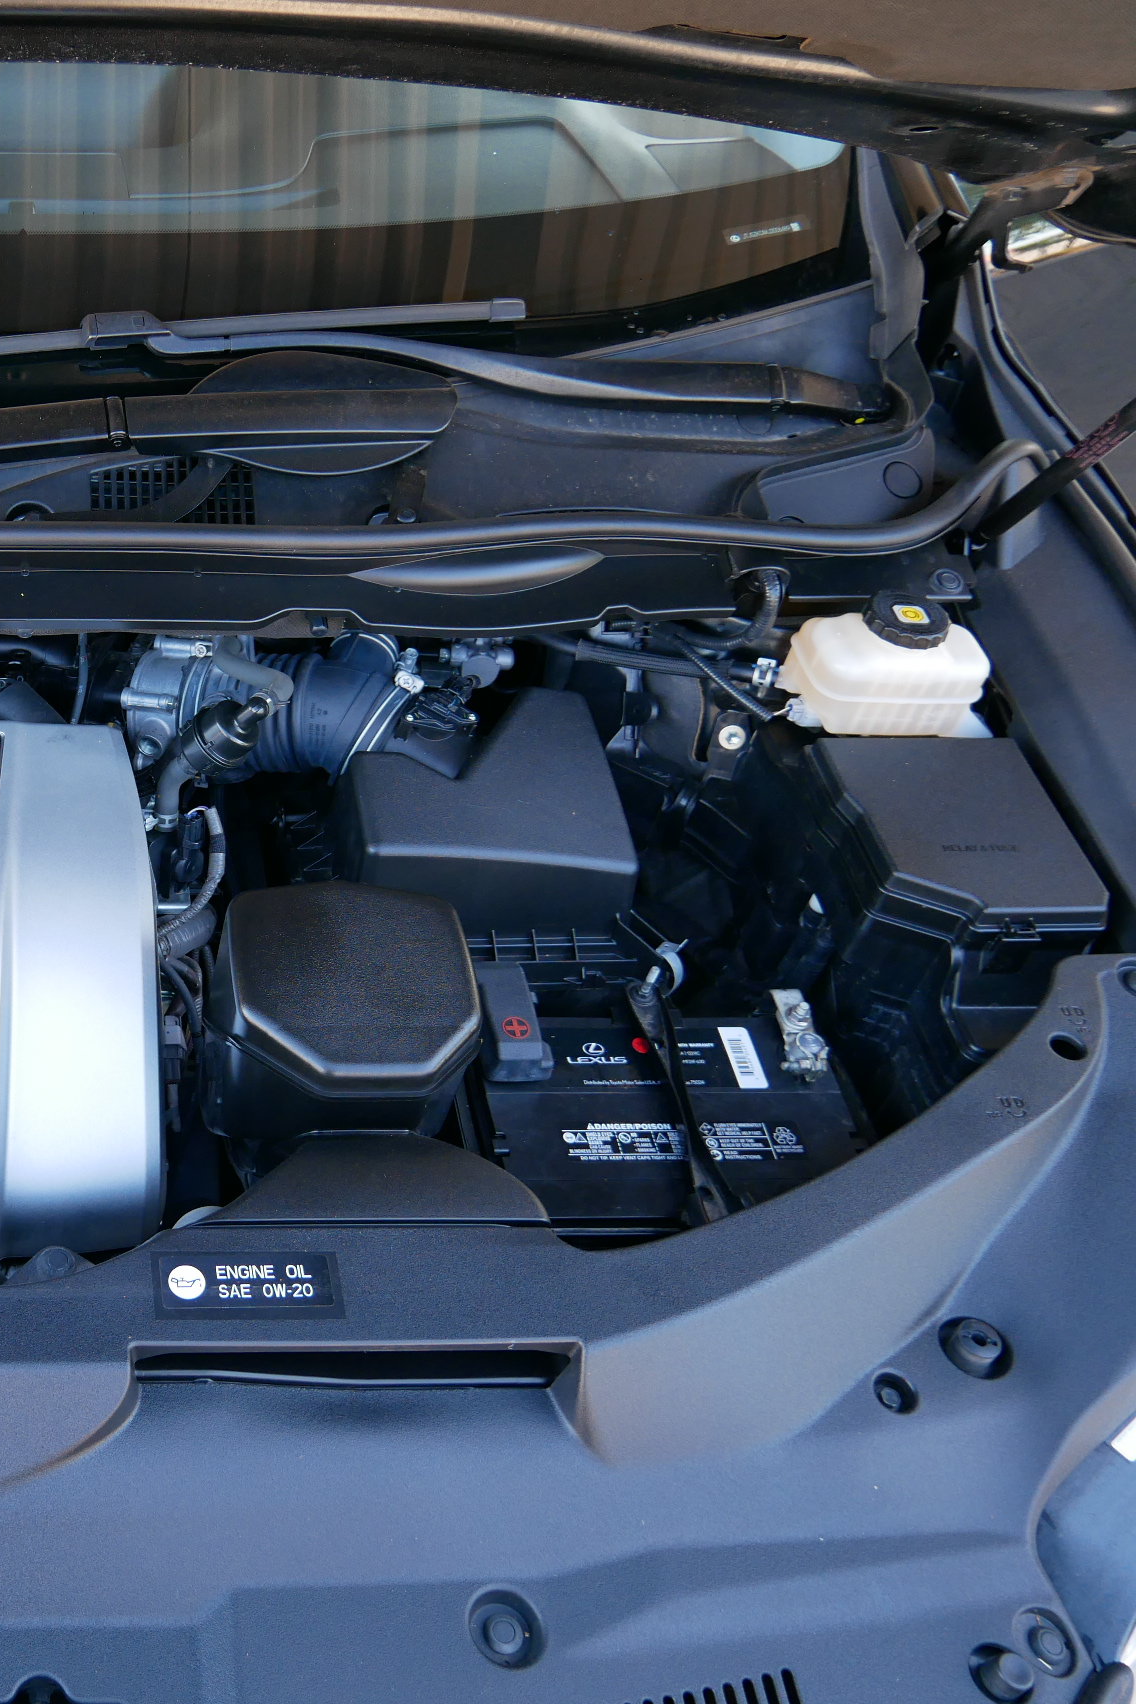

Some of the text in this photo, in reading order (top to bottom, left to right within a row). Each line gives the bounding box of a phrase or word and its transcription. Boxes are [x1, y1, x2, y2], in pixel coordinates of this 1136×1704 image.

[566, 1056, 627, 1064] LEXUS
[215, 1264, 312, 1280] ENGINE OIL
[218, 1283, 314, 1299] SAE 0W-20
